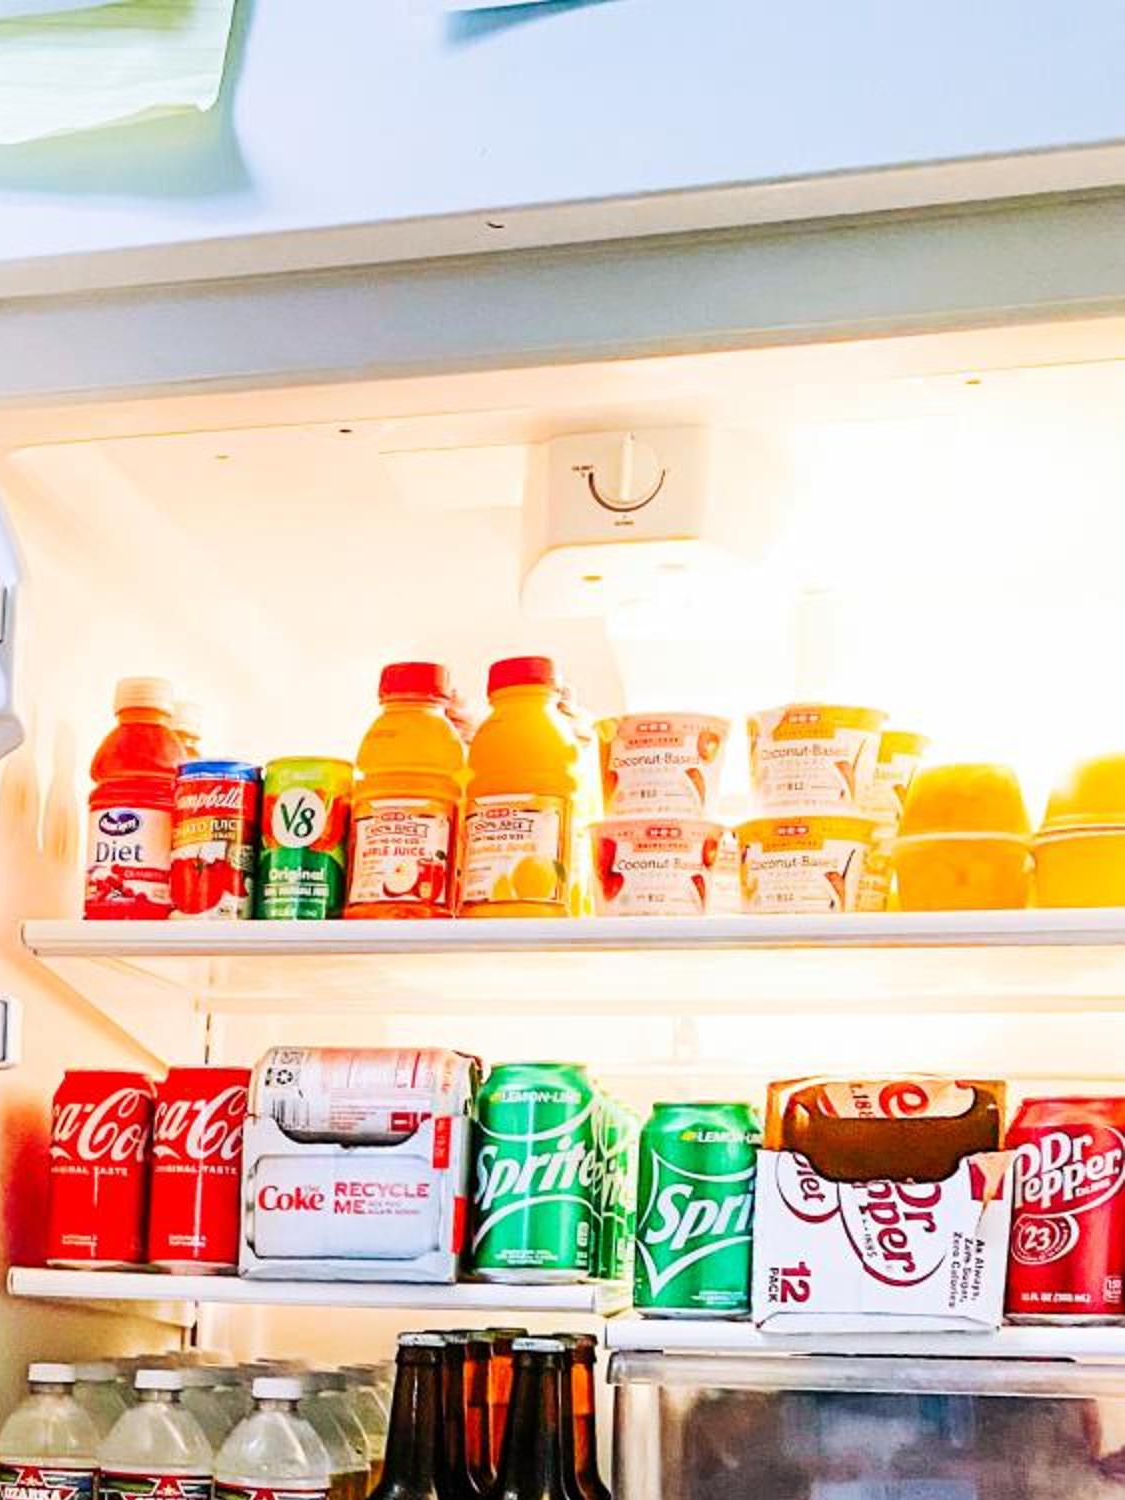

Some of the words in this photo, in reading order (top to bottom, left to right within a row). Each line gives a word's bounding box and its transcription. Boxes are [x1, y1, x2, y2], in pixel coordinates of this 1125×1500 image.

[280, 797, 316, 839] V8
[95, 840, 144, 863] Diet
[393, 845, 426, 858] JUICE
[268, 866, 325, 882] Original
[1040, 1132, 1094, 1173] Dr
[475, 1136, 599, 1211] Sprite
[258, 1186, 325, 1212] Coke
[334, 1183, 430, 1198] RECYCLE
[333, 1201, 365, 1215] ME
[1025, 1226, 1051, 1251] 23
[768, 1266, 780, 1304] PACK
[780, 1261, 812, 1304] 12
[947, 1265, 960, 1309] Calories
